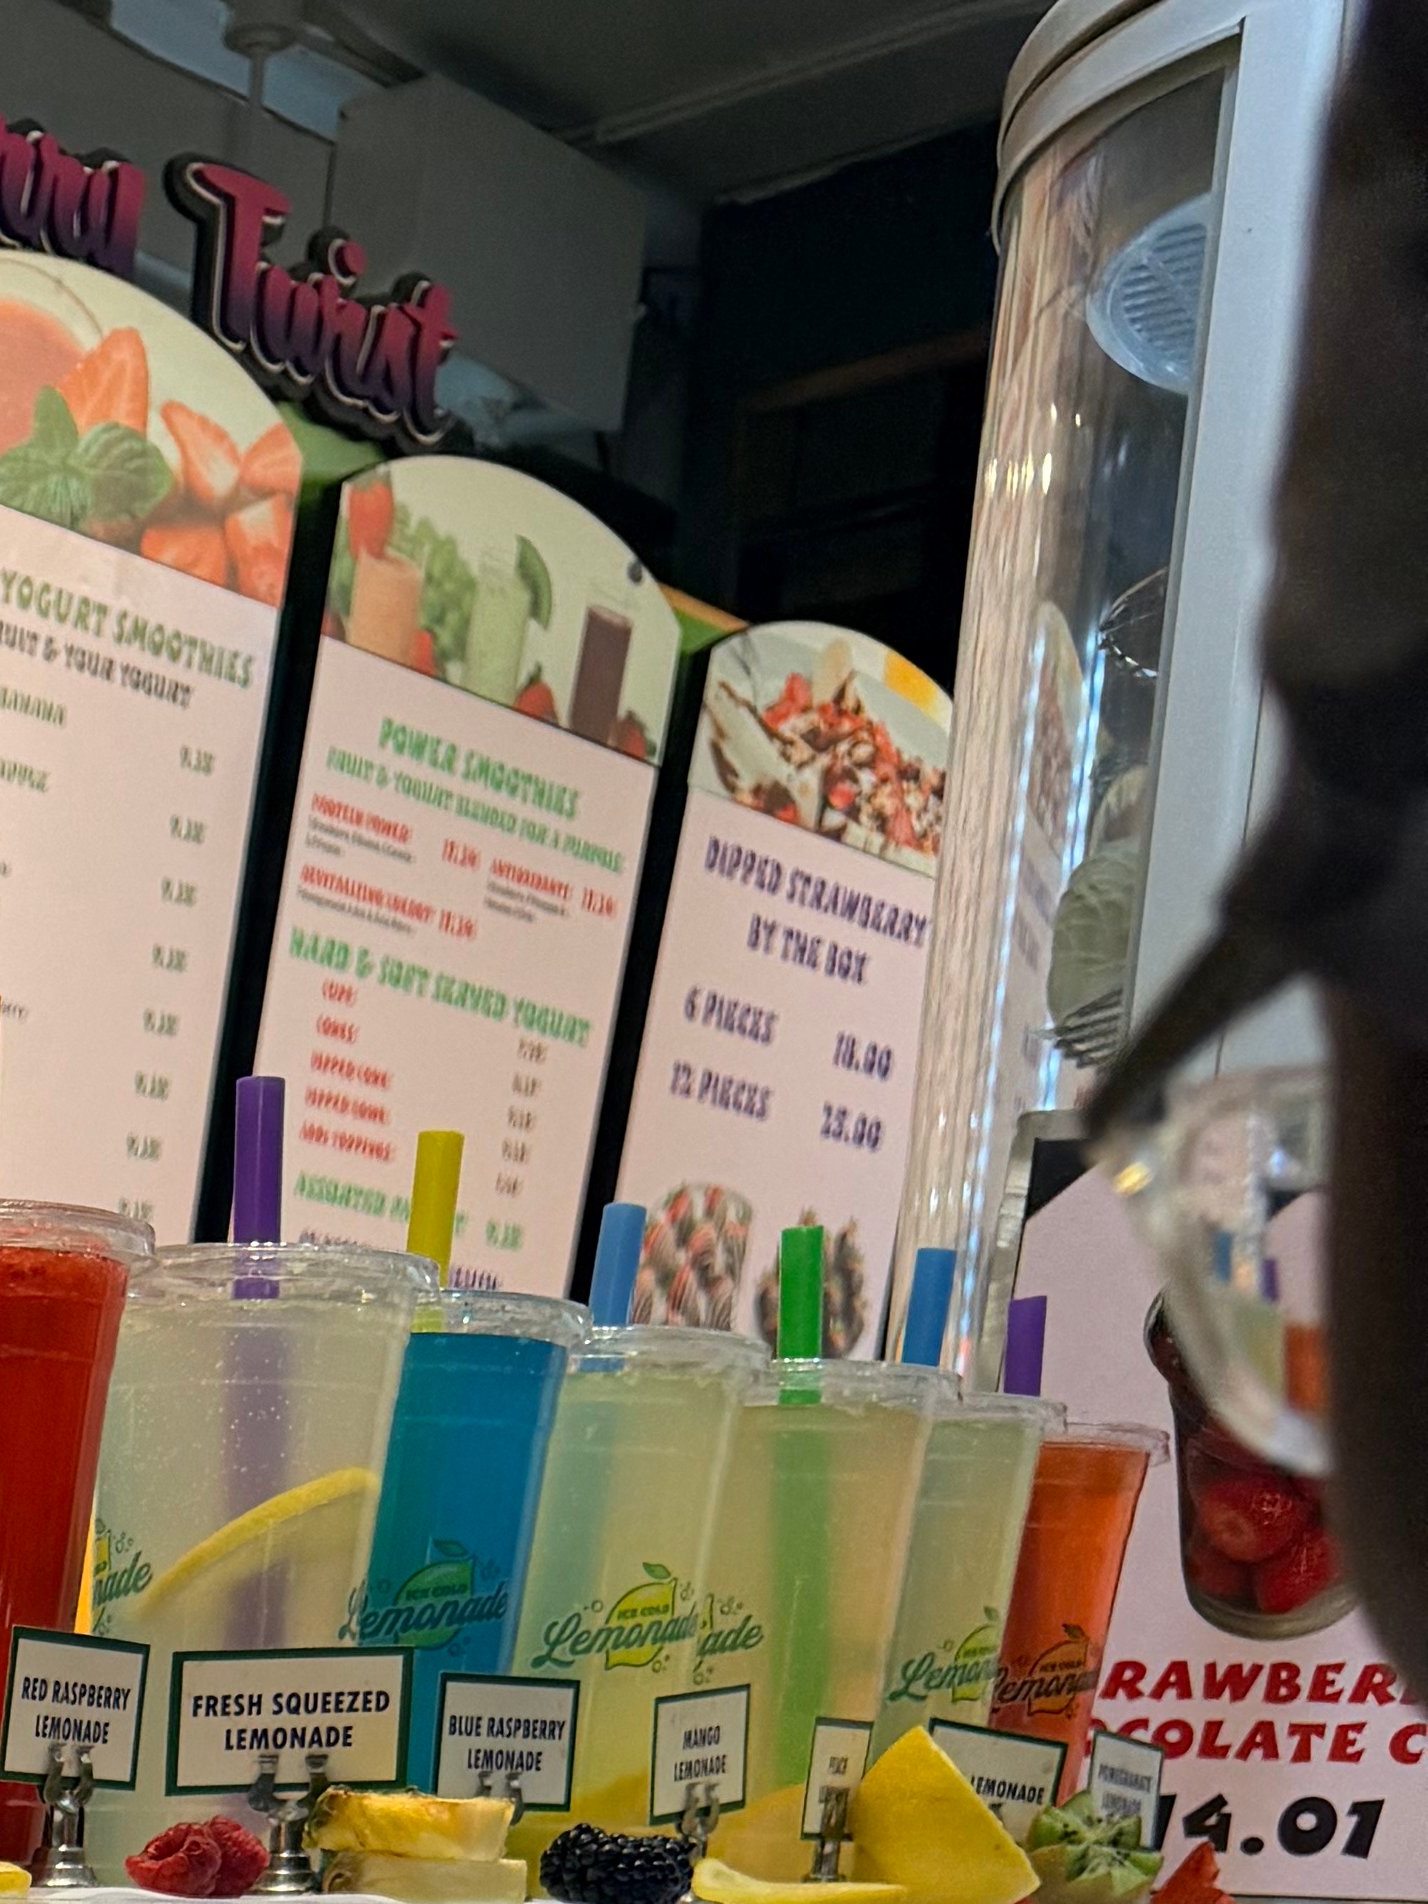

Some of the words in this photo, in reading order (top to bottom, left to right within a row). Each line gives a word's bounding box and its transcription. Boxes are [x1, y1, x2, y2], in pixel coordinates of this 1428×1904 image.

[169, 159, 458, 449] Twist
[0, 567, 109, 638] YOGURT
[112, 607, 254, 690] SMOOTHIES
[703, 834, 782, 897] DIPPED
[786, 868, 928, 948] STRAWBERRY
[747, 913, 779, 955] BY
[780, 927, 819, 969] THE
[824, 949, 868, 986] BOX
[22, 1676, 47, 1701] RED
[52, 1680, 131, 1712] RASPBERRY
[192, 1693, 262, 1718] FRESH
[272, 1690, 389, 1715] SQUEEZED
[35, 1714, 110, 1745] LEMONADE
[225, 1725, 353, 1751] LEMONADE
[449, 1715, 482, 1737] BLUE
[486, 1717, 565, 1741] RASPBERRY
[683, 1725, 721, 1750] MANGO
[1085, 1717, 1367, 1763] COLATE
[467, 1748, 542, 1772] LEMONADE
[674, 1755, 726, 1782] LEMONADE
[971, 1775, 1044, 1805] LEMONADE
